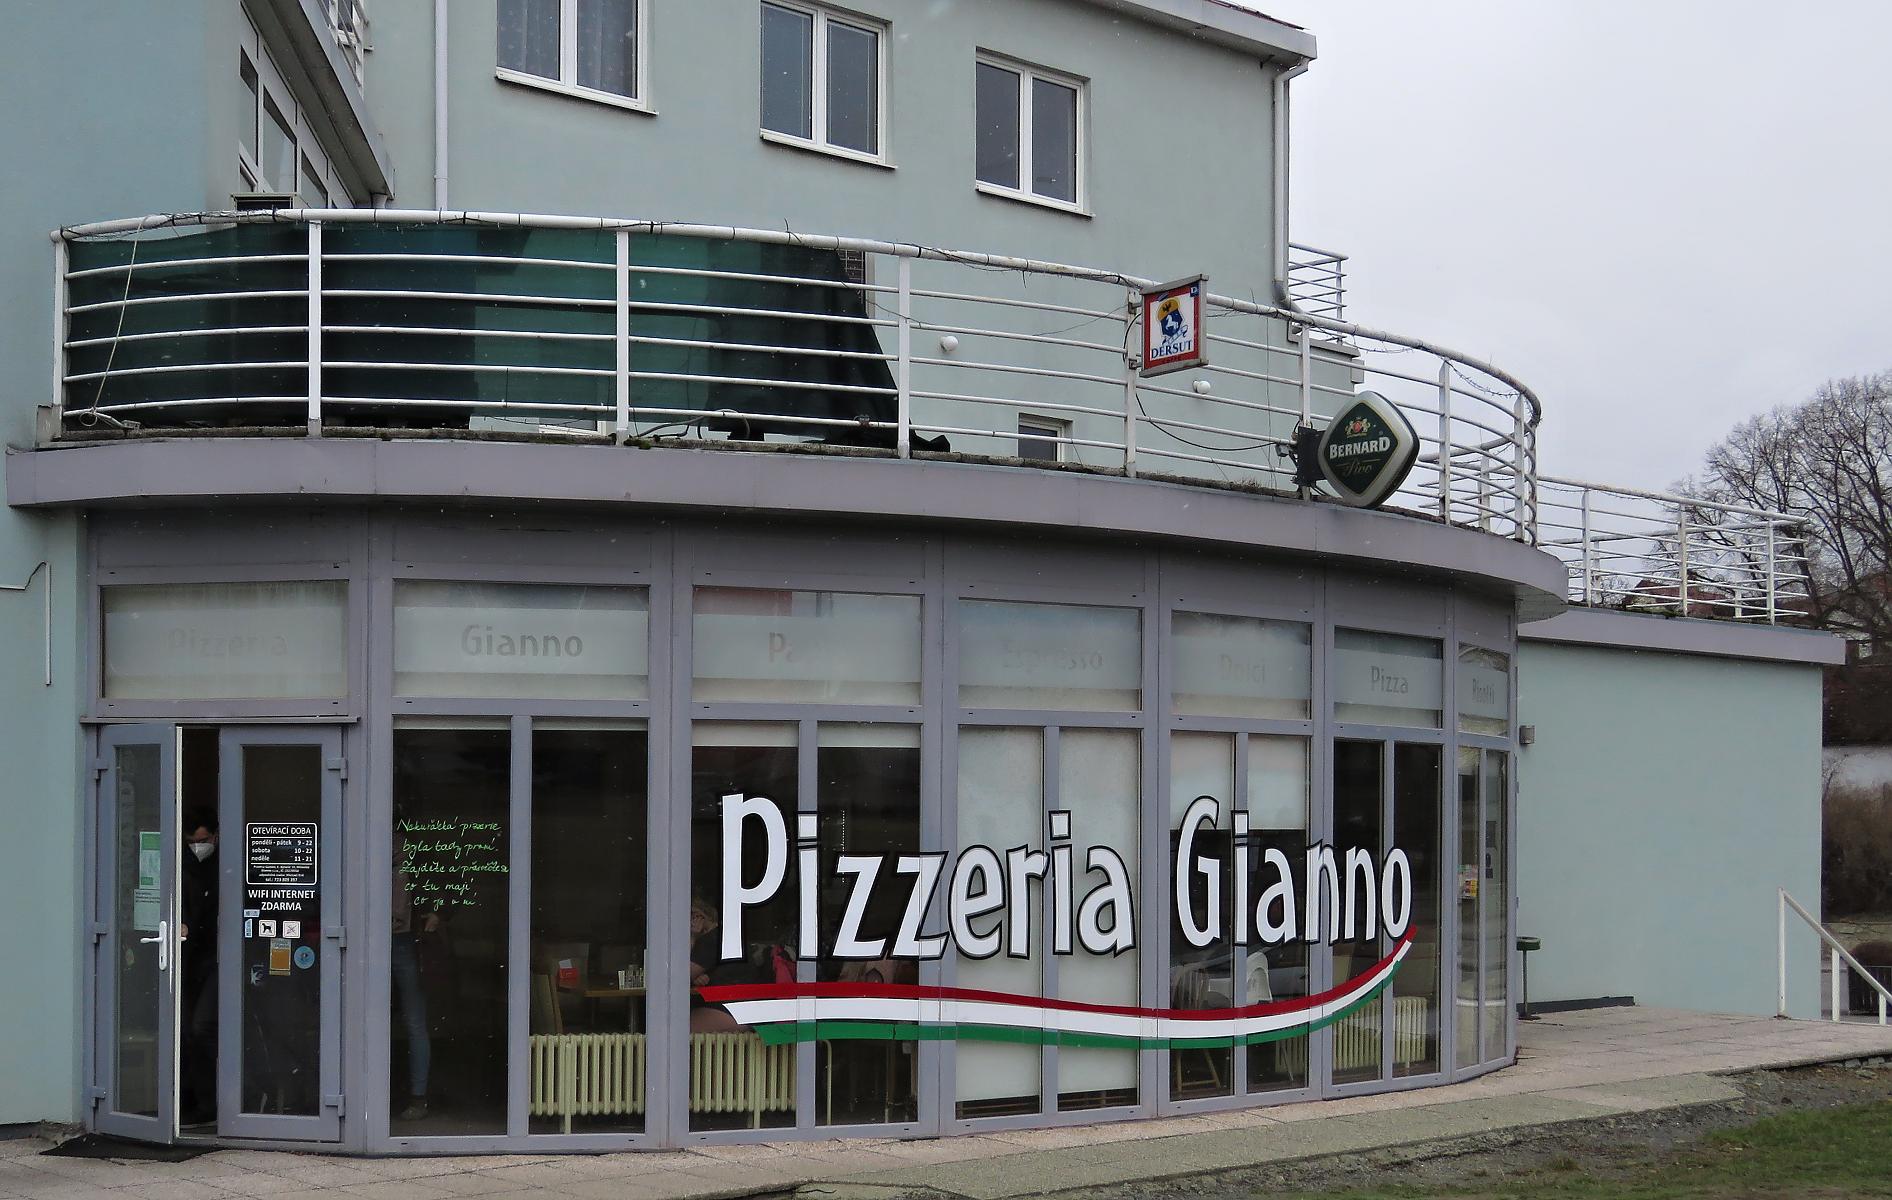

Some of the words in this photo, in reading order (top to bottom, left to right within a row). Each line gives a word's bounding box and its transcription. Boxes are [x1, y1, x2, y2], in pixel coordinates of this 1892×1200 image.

[1151, 340, 1192, 359] DERSUT
[1329, 436, 1391, 460] BERNARD
[461, 624, 583, 657] Gianno
[1371, 665, 1409, 694] Pizza
[252, 825, 290, 835] OTEVÍRACÍ
[290, 827, 312, 835] DOBA
[402, 838, 432, 860] byla
[435, 840, 462, 859] tady
[404, 882, 418, 891] co
[422, 880, 440, 891] tu
[719, 792, 1137, 961] Pizzeria
[1175, 795, 1412, 947] Gianno
[248, 889, 269, 898] WIFI
[270, 889, 316, 899] INTERNET
[261, 901, 302, 911] ZDARMA
